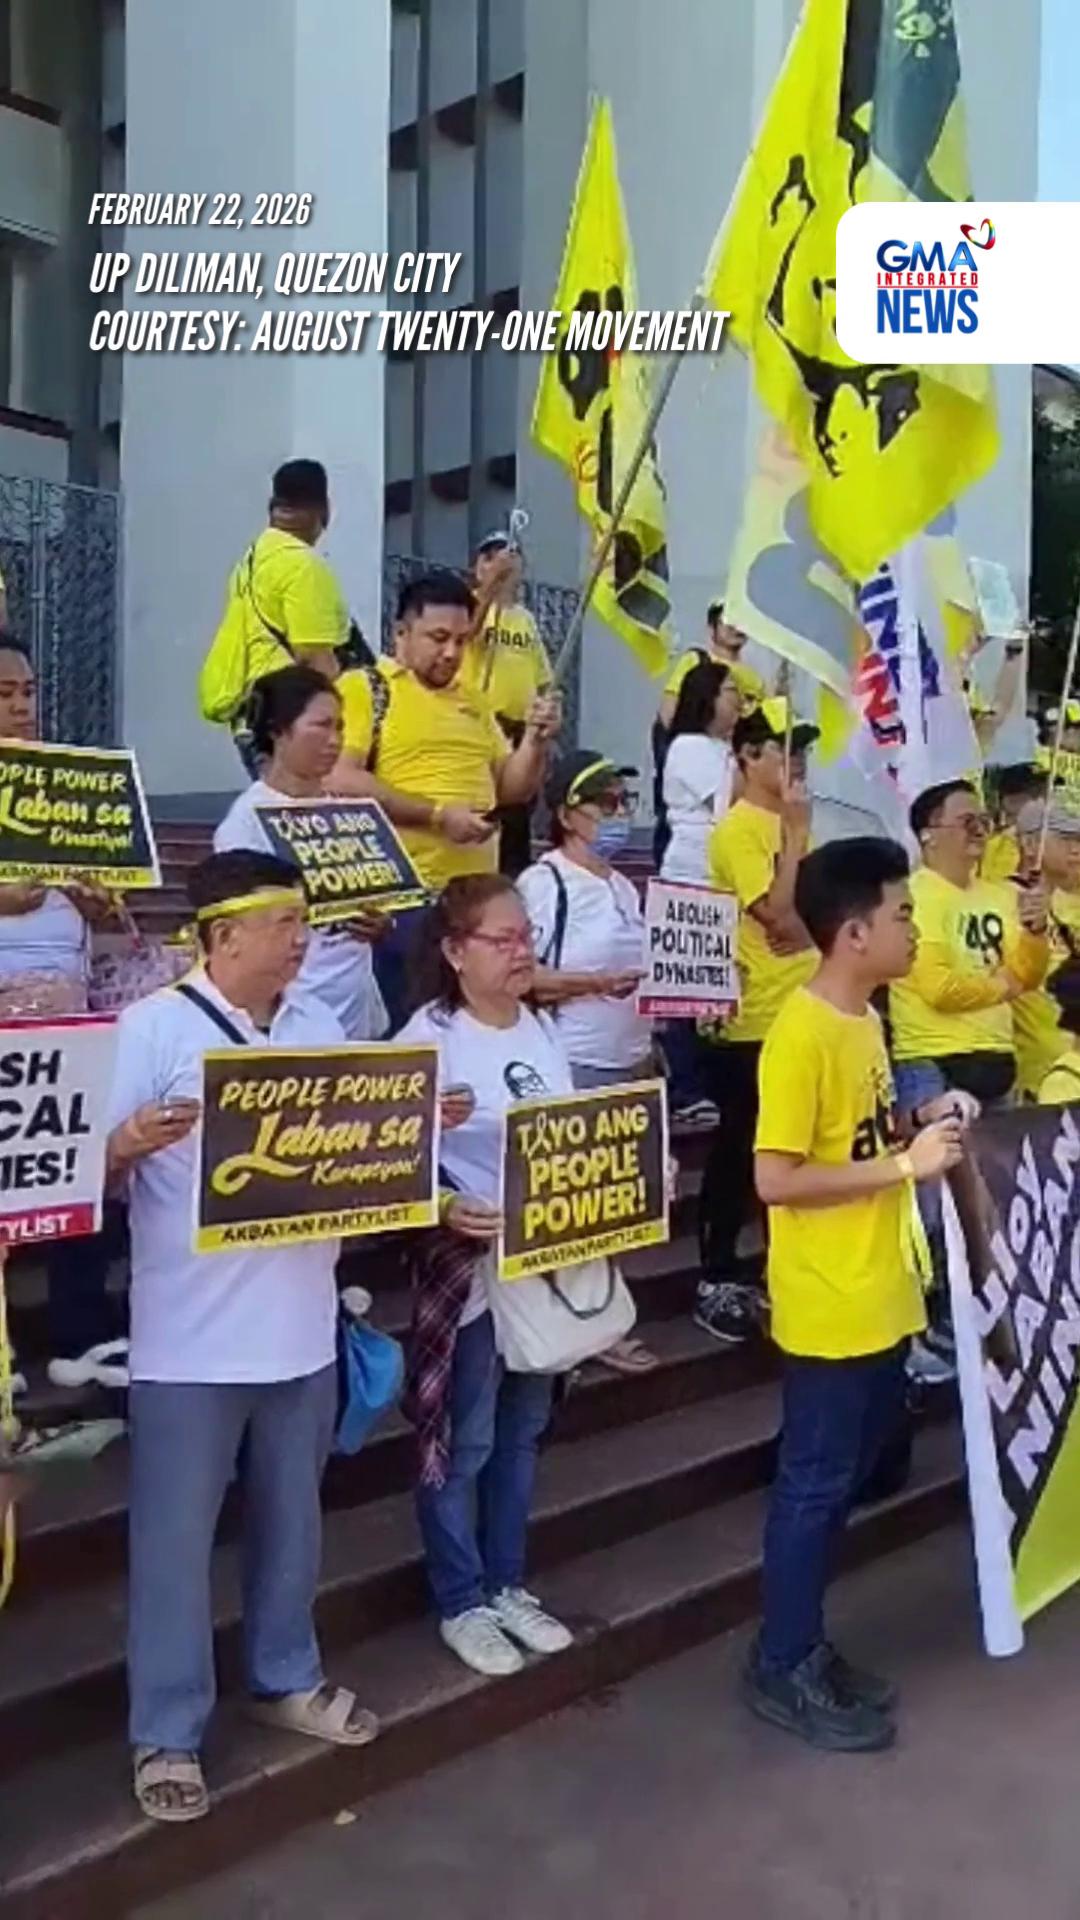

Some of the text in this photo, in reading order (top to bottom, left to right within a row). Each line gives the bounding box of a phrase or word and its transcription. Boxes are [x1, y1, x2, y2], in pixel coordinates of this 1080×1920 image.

[53, 767, 128, 793] POWER
[0, 784, 132, 835] Laban sa
[331, 811, 378, 834] ANG
[291, 834, 387, 866] PEOPLE
[302, 858, 404, 896] POWER!
[665, 899, 723, 927] ABOLISH
[650, 925, 732, 959] POLITICAL
[218, 1070, 427, 1112] PEOPLE POWER
[516, 1103, 650, 1160] TAYO ANG
[211, 1109, 424, 1196] Laban sa
[529, 1140, 641, 1197] PEOPLE
[220, 1205, 415, 1243] AKBAYAN PARTYLIST
[523, 1177, 647, 1241] POWER!
